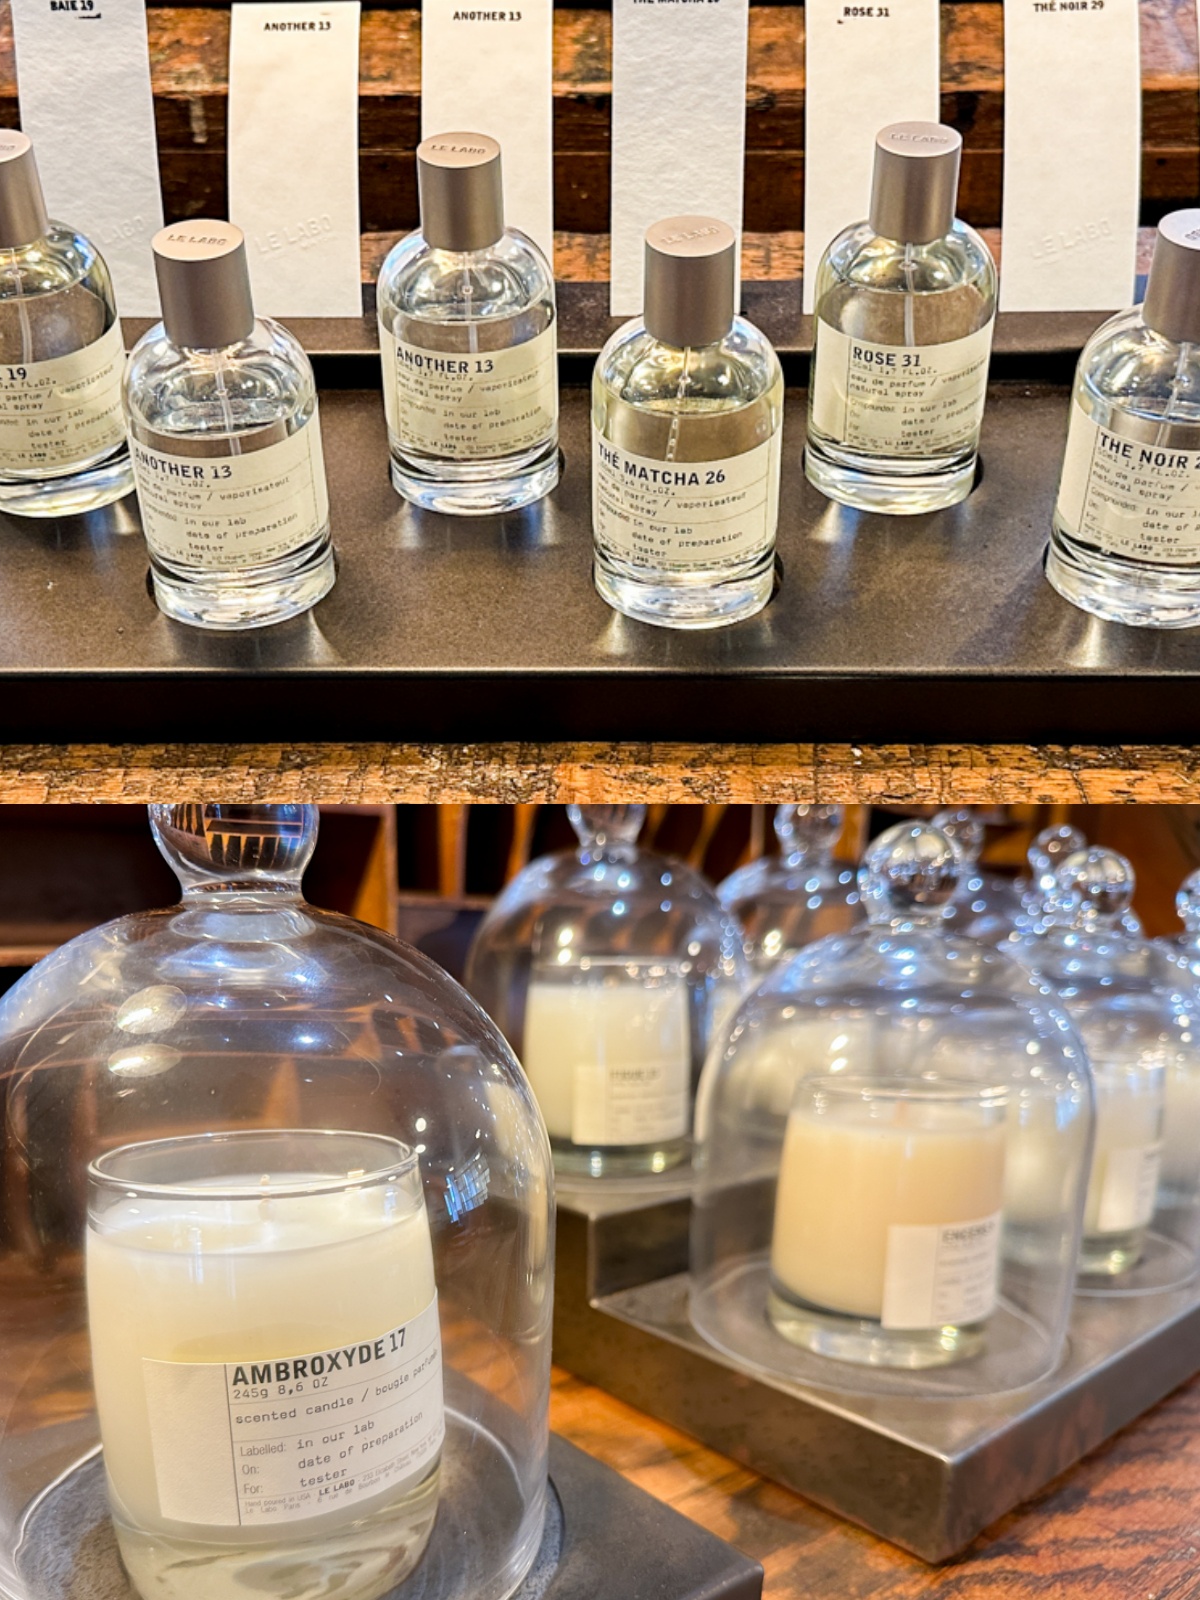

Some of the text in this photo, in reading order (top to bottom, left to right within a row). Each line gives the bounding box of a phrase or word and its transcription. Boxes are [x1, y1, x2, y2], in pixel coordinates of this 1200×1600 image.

[50, 0, 93, 11] BAIE 19
[453, 11, 522, 21] ANOTHER 13
[843, 7, 890, 17] ROSE 31
[1060, 1, 1088, 11] NOIR
[264, 21, 331, 31] ANOTHER 13
[397, 346, 494, 374] ANOTHER 13
[853, 346, 921, 367] ROSE 31
[7, 367, 27, 380] 19
[135, 447, 205, 479] ANOTHER
[210, 465, 232, 479] 13
[598, 442, 620, 469] THÉ
[624, 461, 699, 486] MATCHA
[705, 469, 726, 485] 26
[1139, 449, 1189, 469] NOIR
[232, 1327, 406, 1386] AMBROXYDE 17
[233, 1387, 268, 1399] 245g
[313, 1376, 328, 1389] OZ
[236, 1407, 297, 1424] scented
[306, 1396, 354, 1415] candle
[375, 1374, 409, 1396] bougie
[240, 1420, 375, 1456] Labelled: in our lab
[241, 1411, 423, 1475] On: date of preparation
[243, 1468, 347, 1494] For: tester
[319, 1487, 330, 1496] LE
[333, 1479, 355, 1492] LABO
